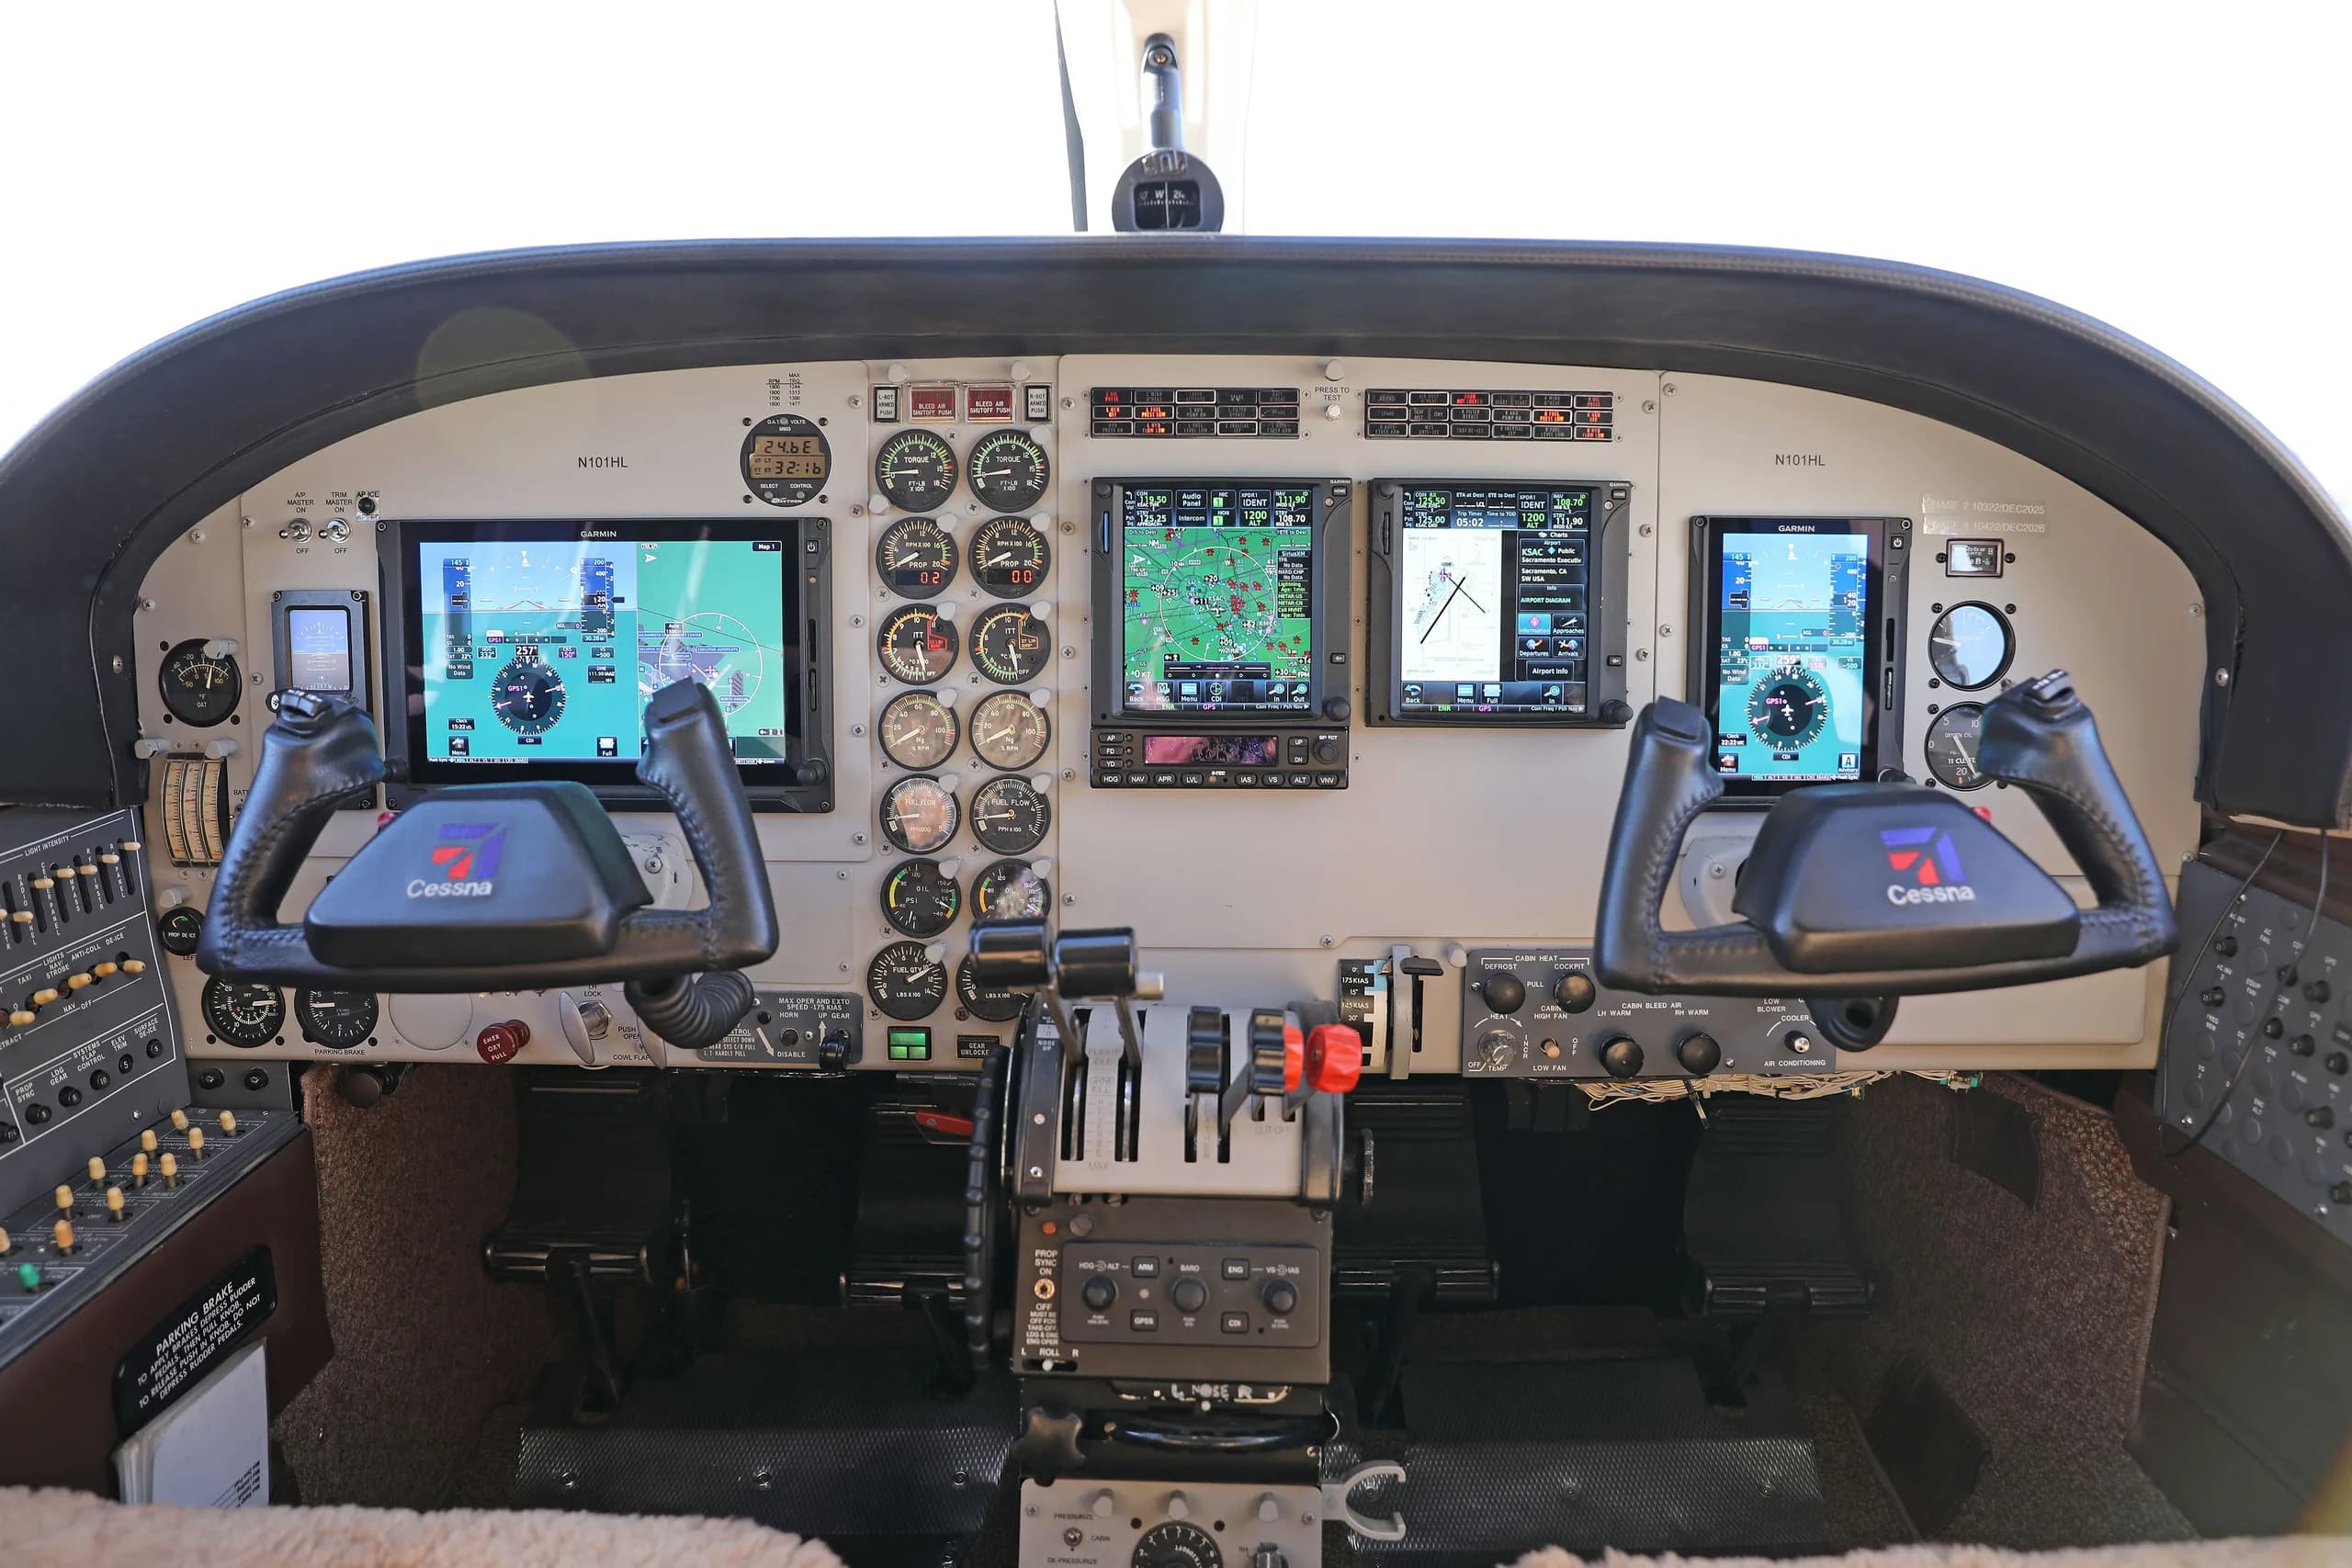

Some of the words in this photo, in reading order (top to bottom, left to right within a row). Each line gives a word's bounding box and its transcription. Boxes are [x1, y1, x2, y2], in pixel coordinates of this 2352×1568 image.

[578, 457, 628, 468] N101HL
[1775, 455, 1826, 466] N101HL
[1555, 498, 1583, 506] 108.70
[1139, 514, 1167, 523] 125.25
[1244, 511, 1267, 519] 1200
[1278, 514, 1306, 523] 108.70
[1521, 513, 1544, 522] 1200
[1456, 518, 1484, 526] 05:02
[25, 846, 41, 857] LIGHT
[42, 835, 70, 852] INTENSITY
[406, 879, 492, 898] Cessna
[1887, 885, 1975, 906] Cessna
[71, 943, 101, 962] ANTI-COLL
[106, 932, 125, 946] DE-ICE
[43, 952, 64, 965] LIGHTS
[46, 964, 70, 979] STROBE
[17, 975, 32, 986] TAXI
[63, 1002, 76, 1012] NAV
[80, 998, 93, 1010] OFF
[134, 1018, 159, 1034] SURFACE
[111, 1034, 126, 1047] ELEV
[482, 1033, 501, 1044] EMER
[74, 1040, 101, 1059] SYSTEMS
[114, 1041, 128, 1052] TRIM
[487, 1043, 501, 1053] OXY
[82, 1049, 97, 1062] FLAP
[491, 1051, 507, 1061] PULL
[77, 1055, 106, 1072] CONTROL
[51, 1066, 64, 1078] LDG
[50, 1074, 68, 1086] GEAR
[16, 1082, 33, 1096] PROP
[17, 1089, 35, 1102] SYNC
[1035, 1249, 1057, 1258] PROP
[1035, 1258, 1057, 1267] SYNC
[156, 1311, 199, 1357] PARKING
[202, 1281, 233, 1314] BRAKE
[138, 1373, 147, 1386] TO
[150, 1353, 169, 1374] APPLY
[172, 1326, 198, 1352] BRAKES
[199, 1301, 228, 1328] DEPRESS
[229, 1277, 256, 1303] RUDDER
[154, 1355, 181, 1381] PEDALS.
[184, 1334, 201, 1353] THEN
[202, 1320, 218, 1336] PULL
[220, 1300, 242, 1323] KNOB.
[139, 1394, 149, 1409] TO
[151, 1367, 177, 1397] RELEASE
[179, 1348, 198, 1370] PUSH
[199, 1340, 208, 1353] IN
[209, 1322, 232, 1344] KNOB.
[232, 1308, 243, 1321] DO
[245, 1292, 262, 1311] NOT
[1039, 1348, 1059, 1356] ROLL
[159, 1369, 187, 1401] DEPRESS
[189, 1344, 216, 1371] RUDDER
[218, 1321, 243, 1345] PEDALS.
